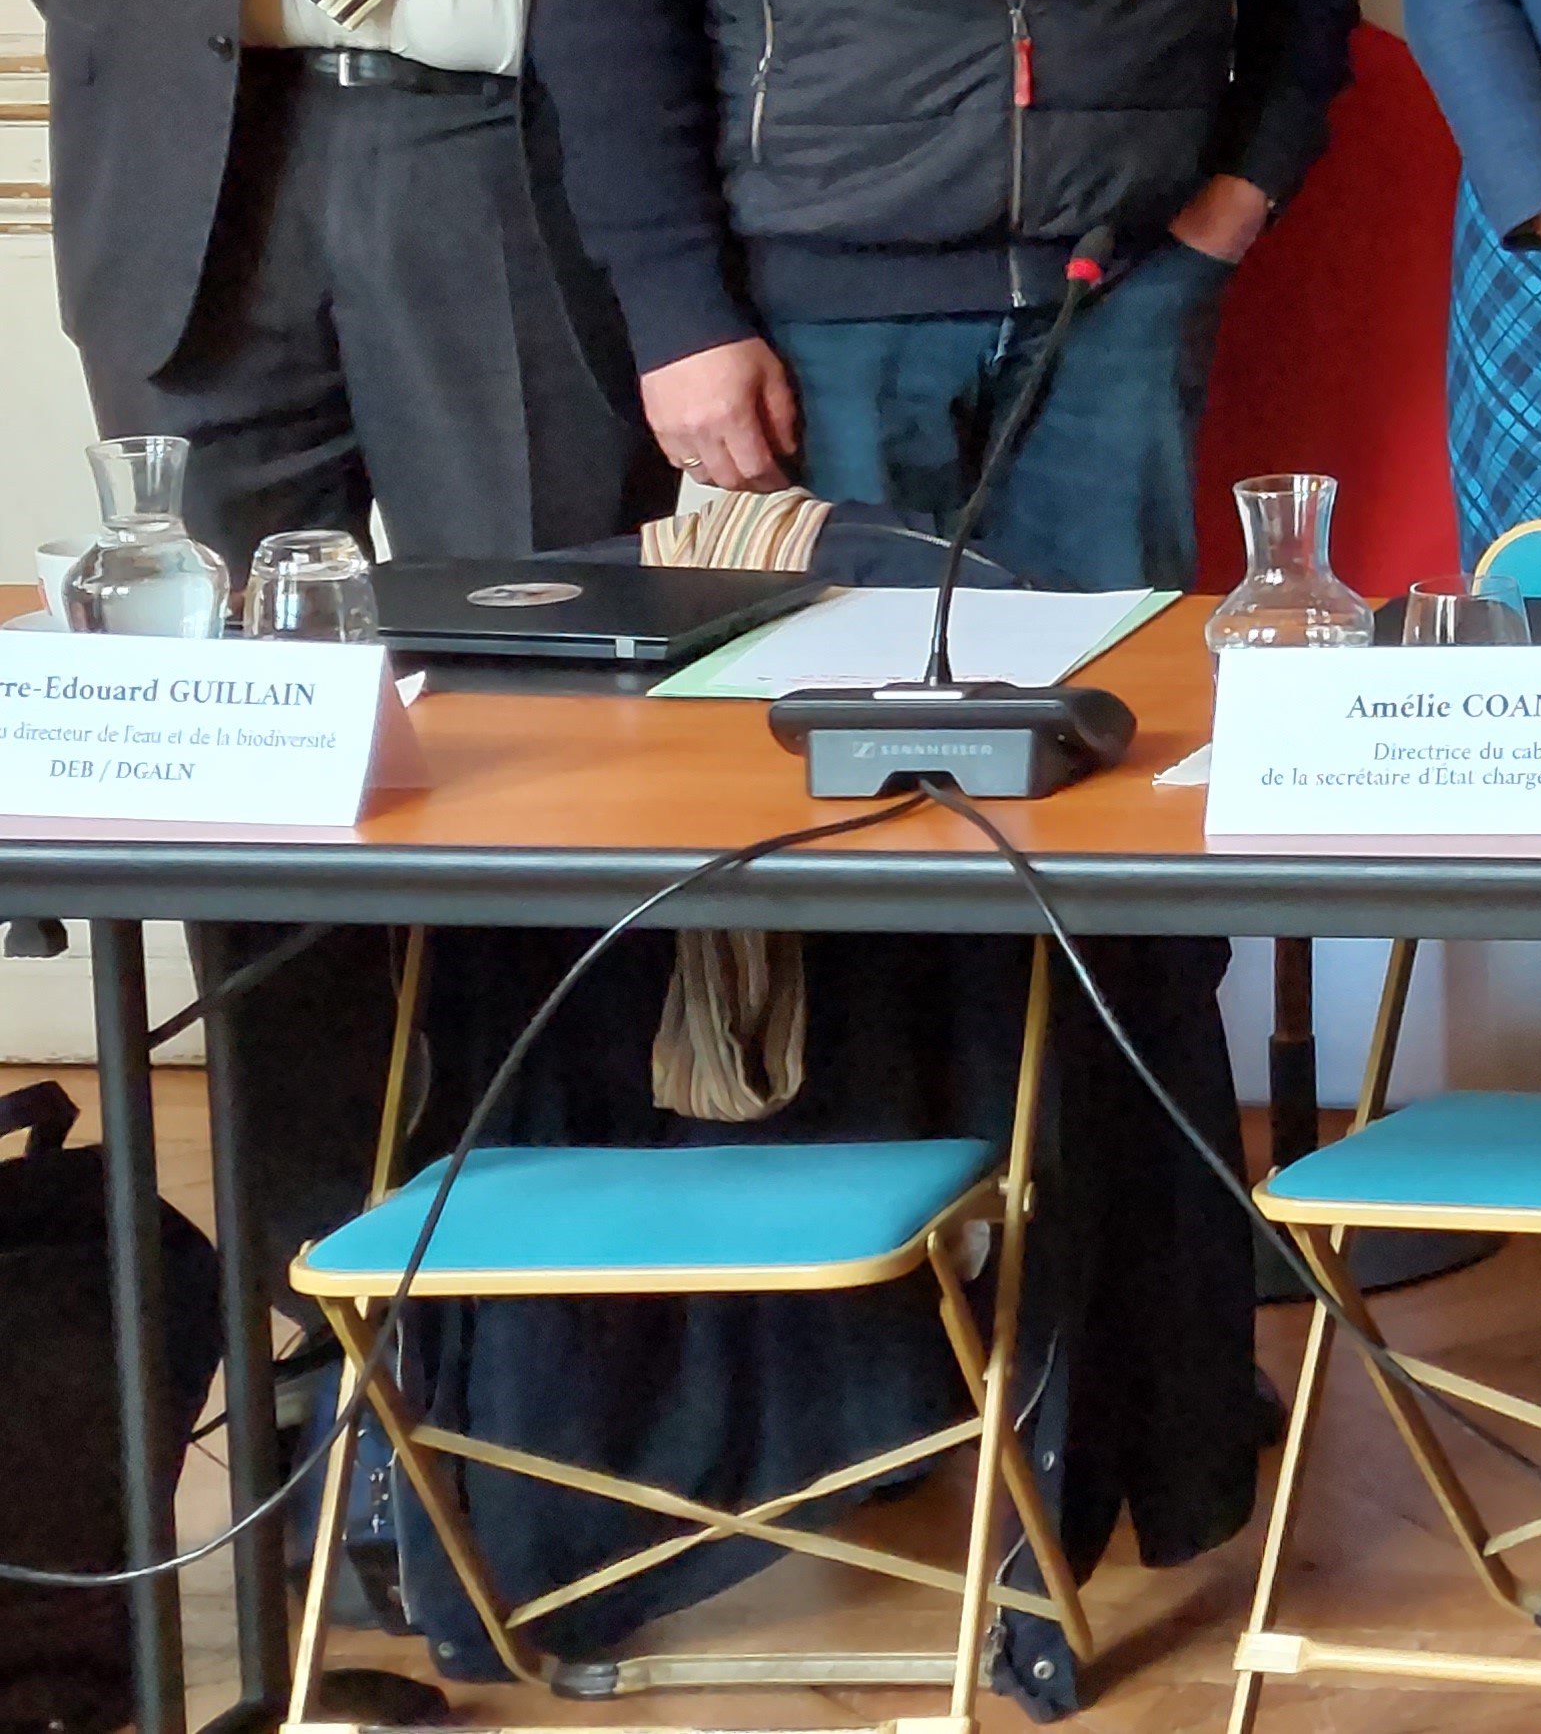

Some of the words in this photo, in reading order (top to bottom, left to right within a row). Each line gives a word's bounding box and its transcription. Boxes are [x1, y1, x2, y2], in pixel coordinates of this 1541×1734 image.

[0, 675, 159, 702] re-Edouard
[169, 679, 316, 706] GUILLAIN
[1345, 693, 1452, 718] Amélie
[13, 721, 94, 742] directeur
[97, 723, 120, 743] de
[123, 724, 162, 744] l'eau
[167, 729, 182, 745] et
[189, 726, 211, 745] de
[216, 726, 231, 746] la
[236, 727, 337, 749] biodiversité
[879, 744, 993, 756] SENNHEISER
[1373, 742, 1472, 760] Directrice
[1479, 741, 1504, 760] du
[49, 759, 94, 778] DEB
[98, 759, 112, 783] /
[115, 761, 196, 781] DGALN
[1261, 767, 1284, 786] de
[1292, 767, 1308, 786] la
[1316, 767, 1411, 786] secrétaire
[1418, 762, 1475, 786] d'État
